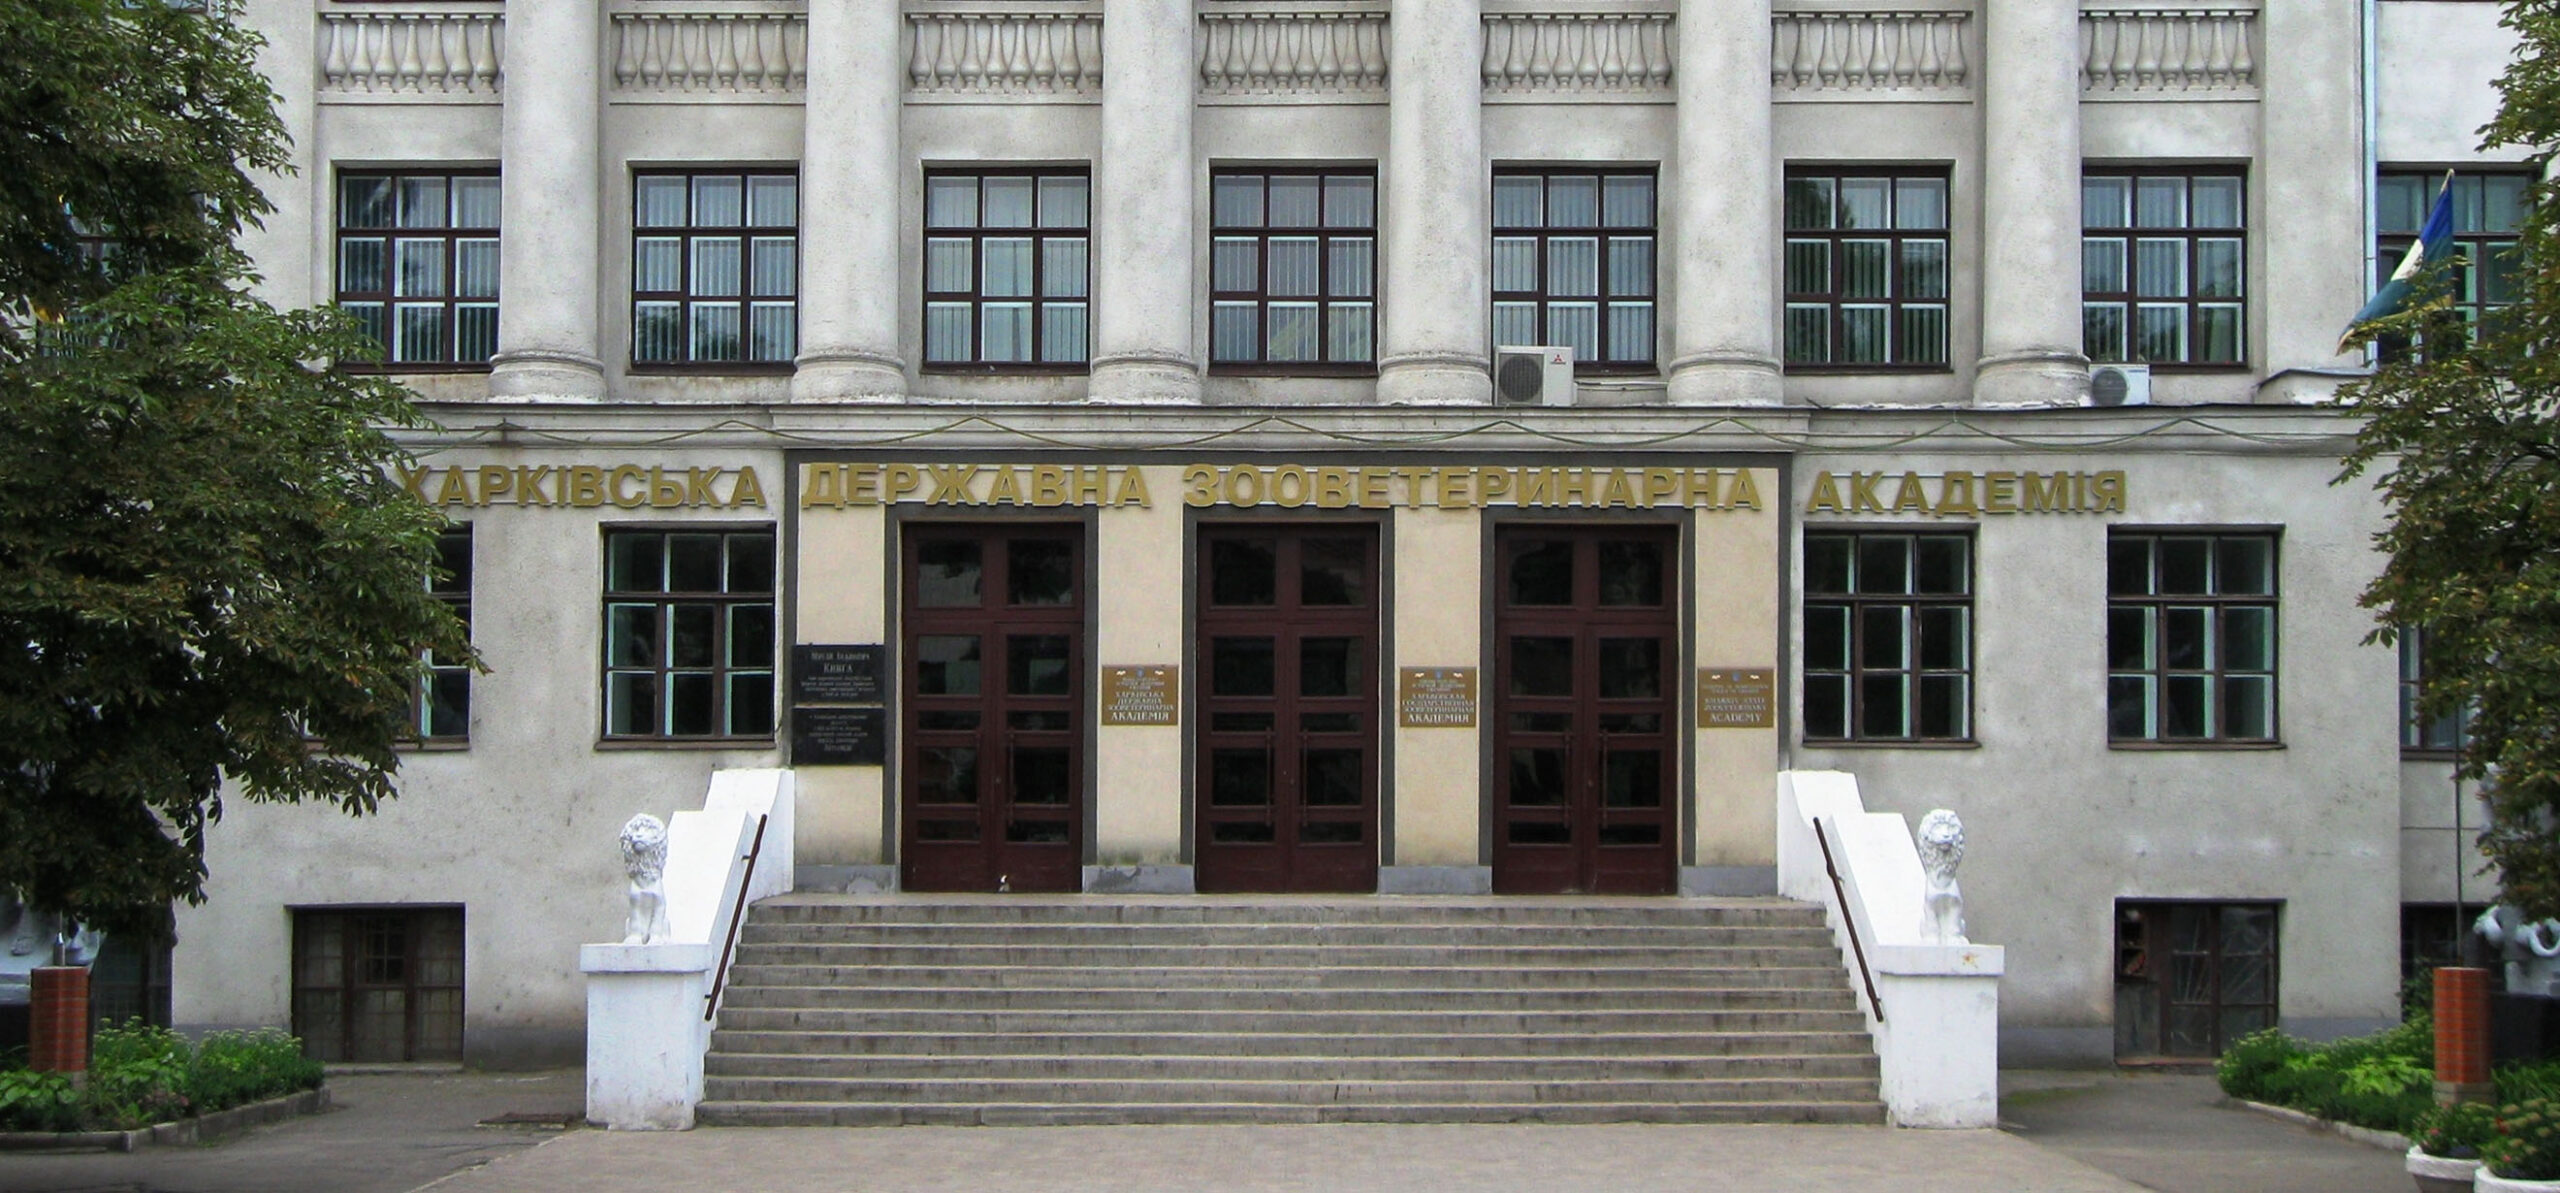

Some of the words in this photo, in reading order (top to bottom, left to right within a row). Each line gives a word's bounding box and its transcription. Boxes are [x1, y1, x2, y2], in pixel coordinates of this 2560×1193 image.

[398, 464, 767, 508] ХАРКІВСЬКА
[802, 463, 1152, 509] ДЕРЖАВНА
[1183, 463, 1763, 511] ЗООВЕТЕРИНАРНА
[1805, 470, 2129, 517] АКАДЕМІЯ
[1111, 711, 1169, 720] АКАДЕМІЯ
[1407, 714, 1470, 723] АКАДЕМИЯ
[1710, 712, 1762, 722] ACADEMY
